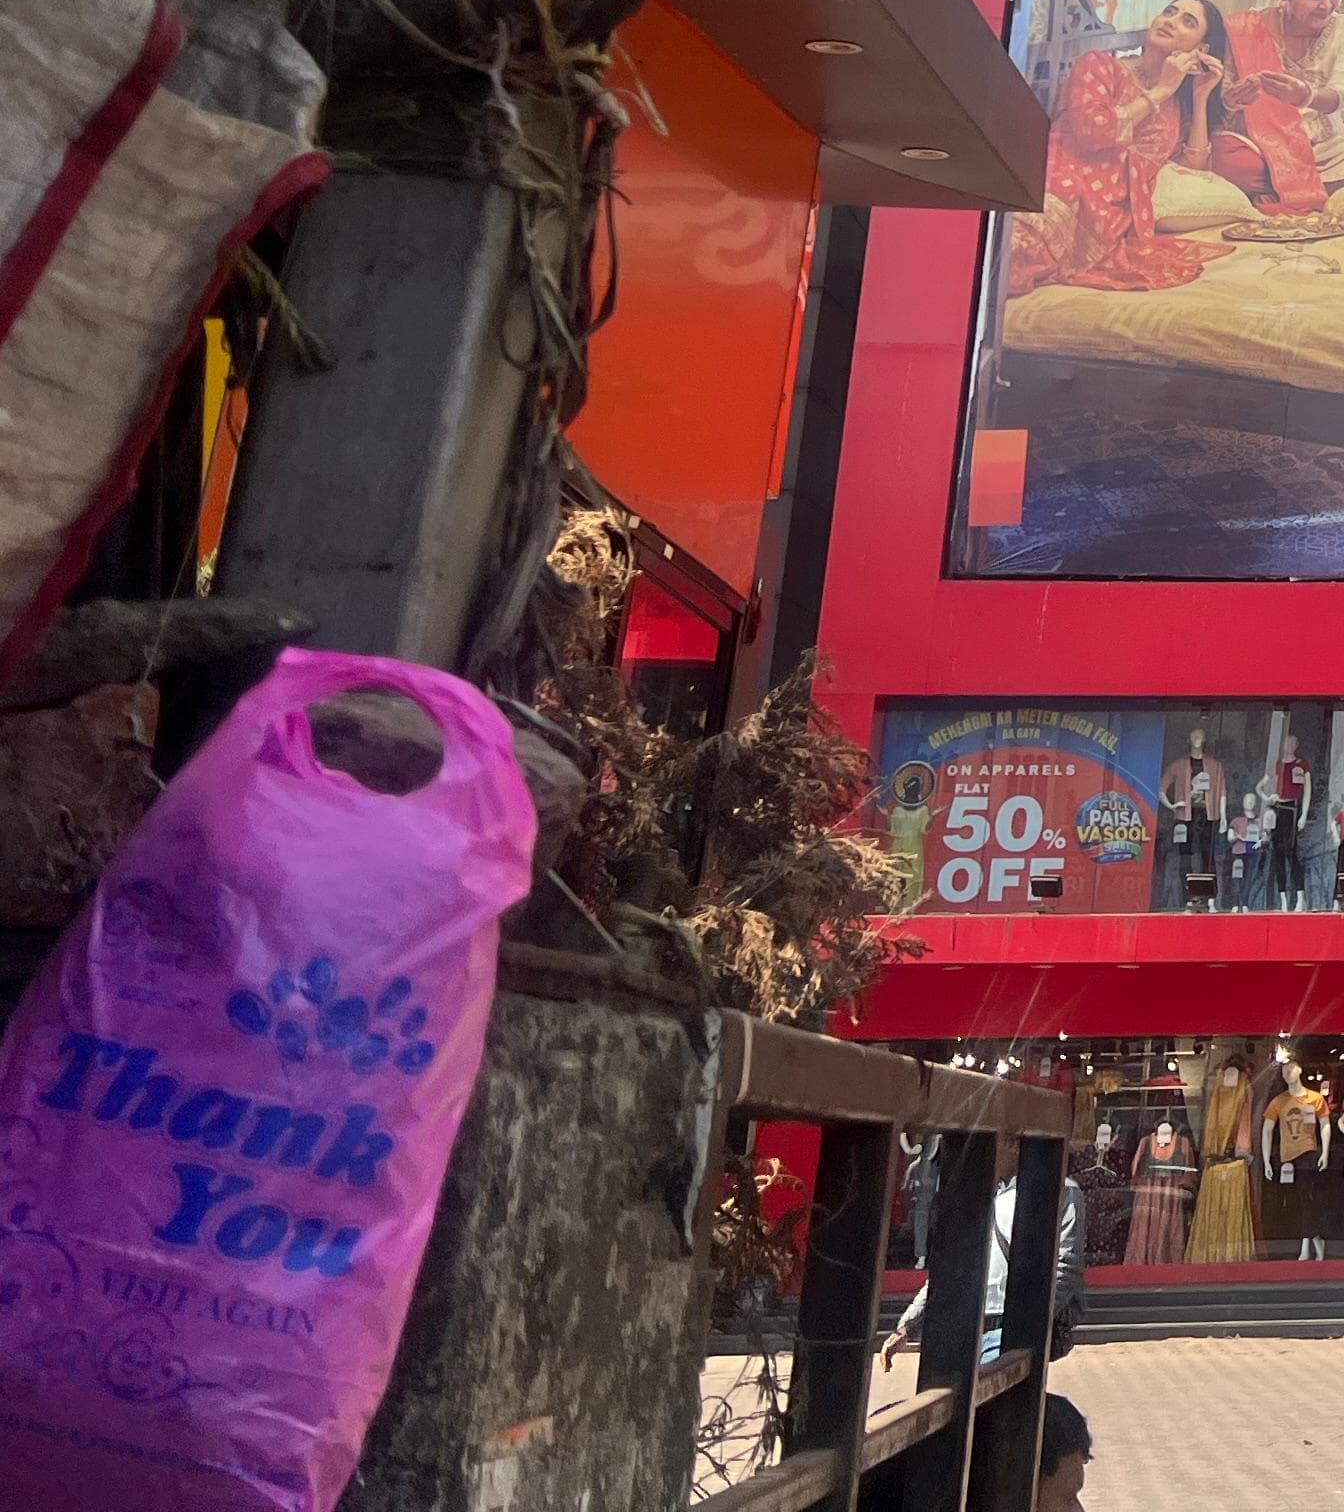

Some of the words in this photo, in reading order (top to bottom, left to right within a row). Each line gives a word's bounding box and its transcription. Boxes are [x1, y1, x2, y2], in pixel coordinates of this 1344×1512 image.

[946, 764, 972, 777] ON
[978, 763, 1077, 777] APPARELS
[954, 782, 991, 794] FLAT
[1088, 808, 1143, 828] PAISA
[1099, 799, 1131, 812] FULL
[942, 795, 1067, 853] 50%
[1076, 825, 1152, 844] VASOOL
[937, 857, 1066, 904] OFF
[39, 1031, 396, 1190] Thank
[154, 1162, 364, 1279] You
[99, 1267, 191, 1315] VISIT
[197, 1288, 317, 1338] AGAIN
